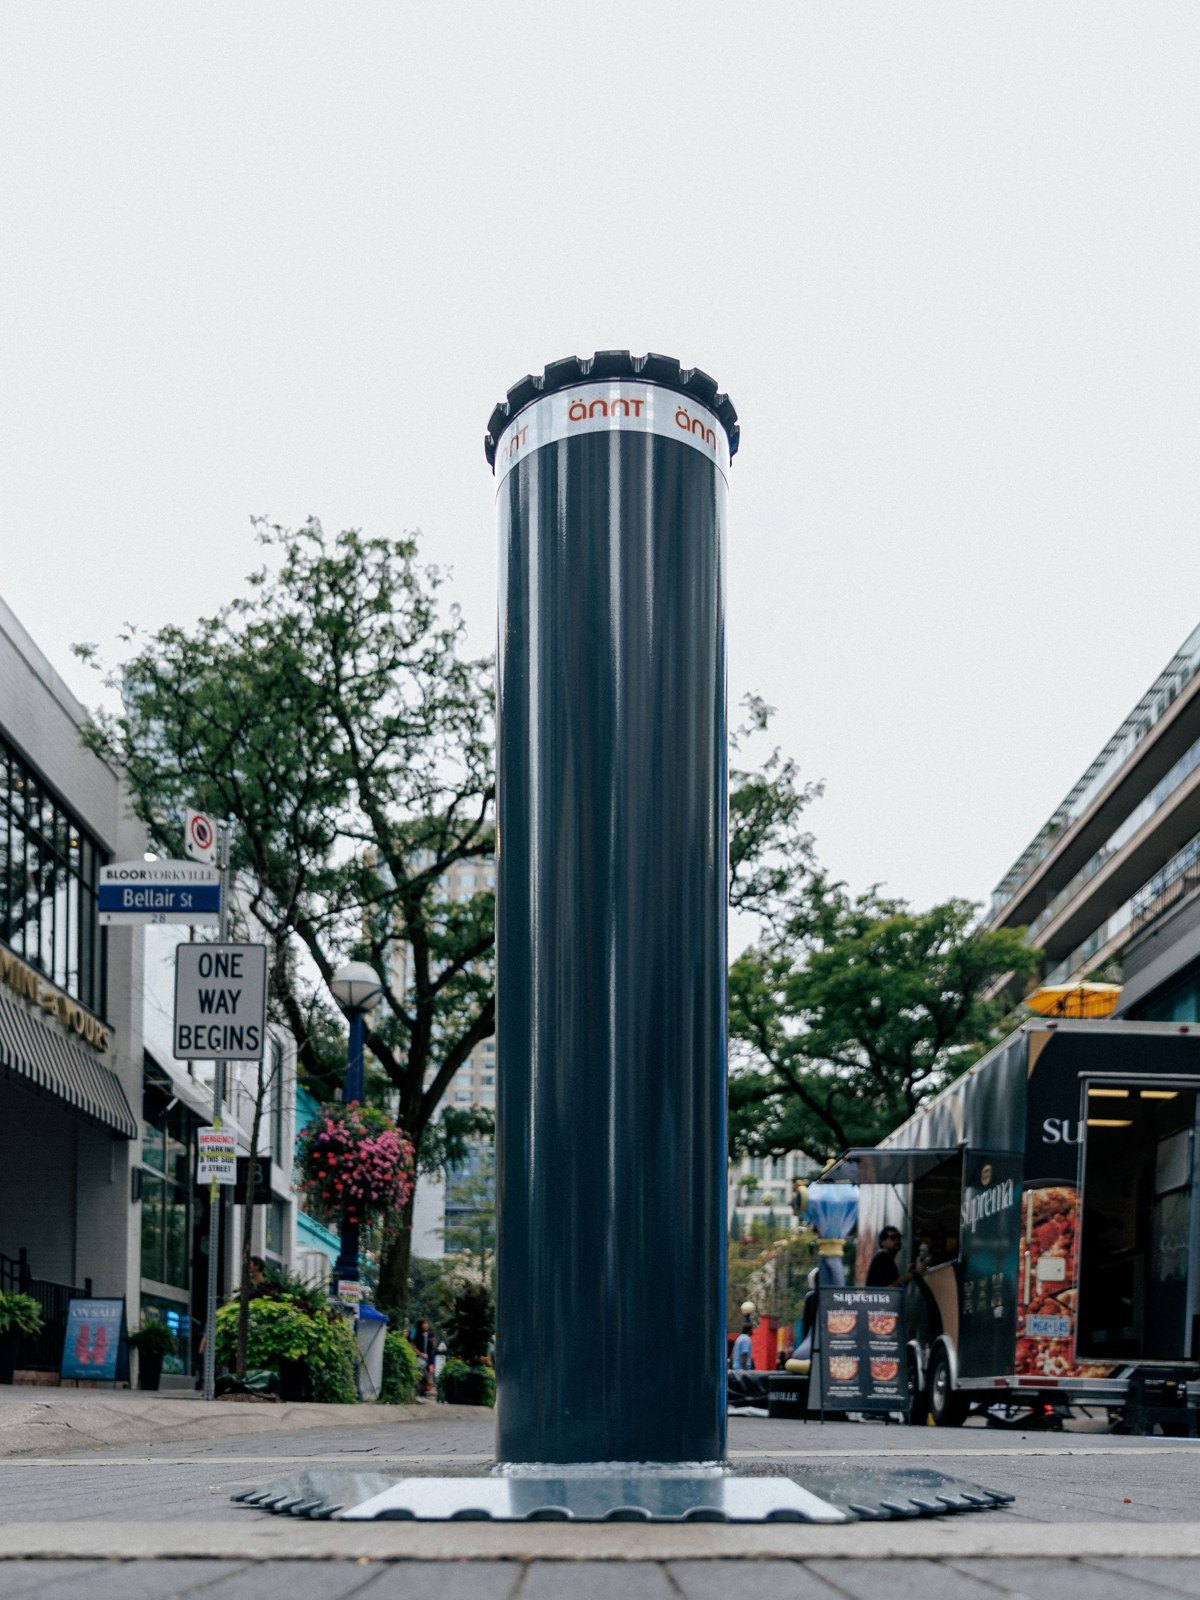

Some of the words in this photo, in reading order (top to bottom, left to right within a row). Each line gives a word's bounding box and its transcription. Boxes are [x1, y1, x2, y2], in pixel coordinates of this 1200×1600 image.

[123, 888, 175, 908] Bellair
[180, 893, 193, 907] St
[198, 953, 244, 978] ONE
[198, 989, 242, 1014] WAY
[178, 1025, 259, 1051] BEGINS
[833, 1292, 891, 1306] suprema
